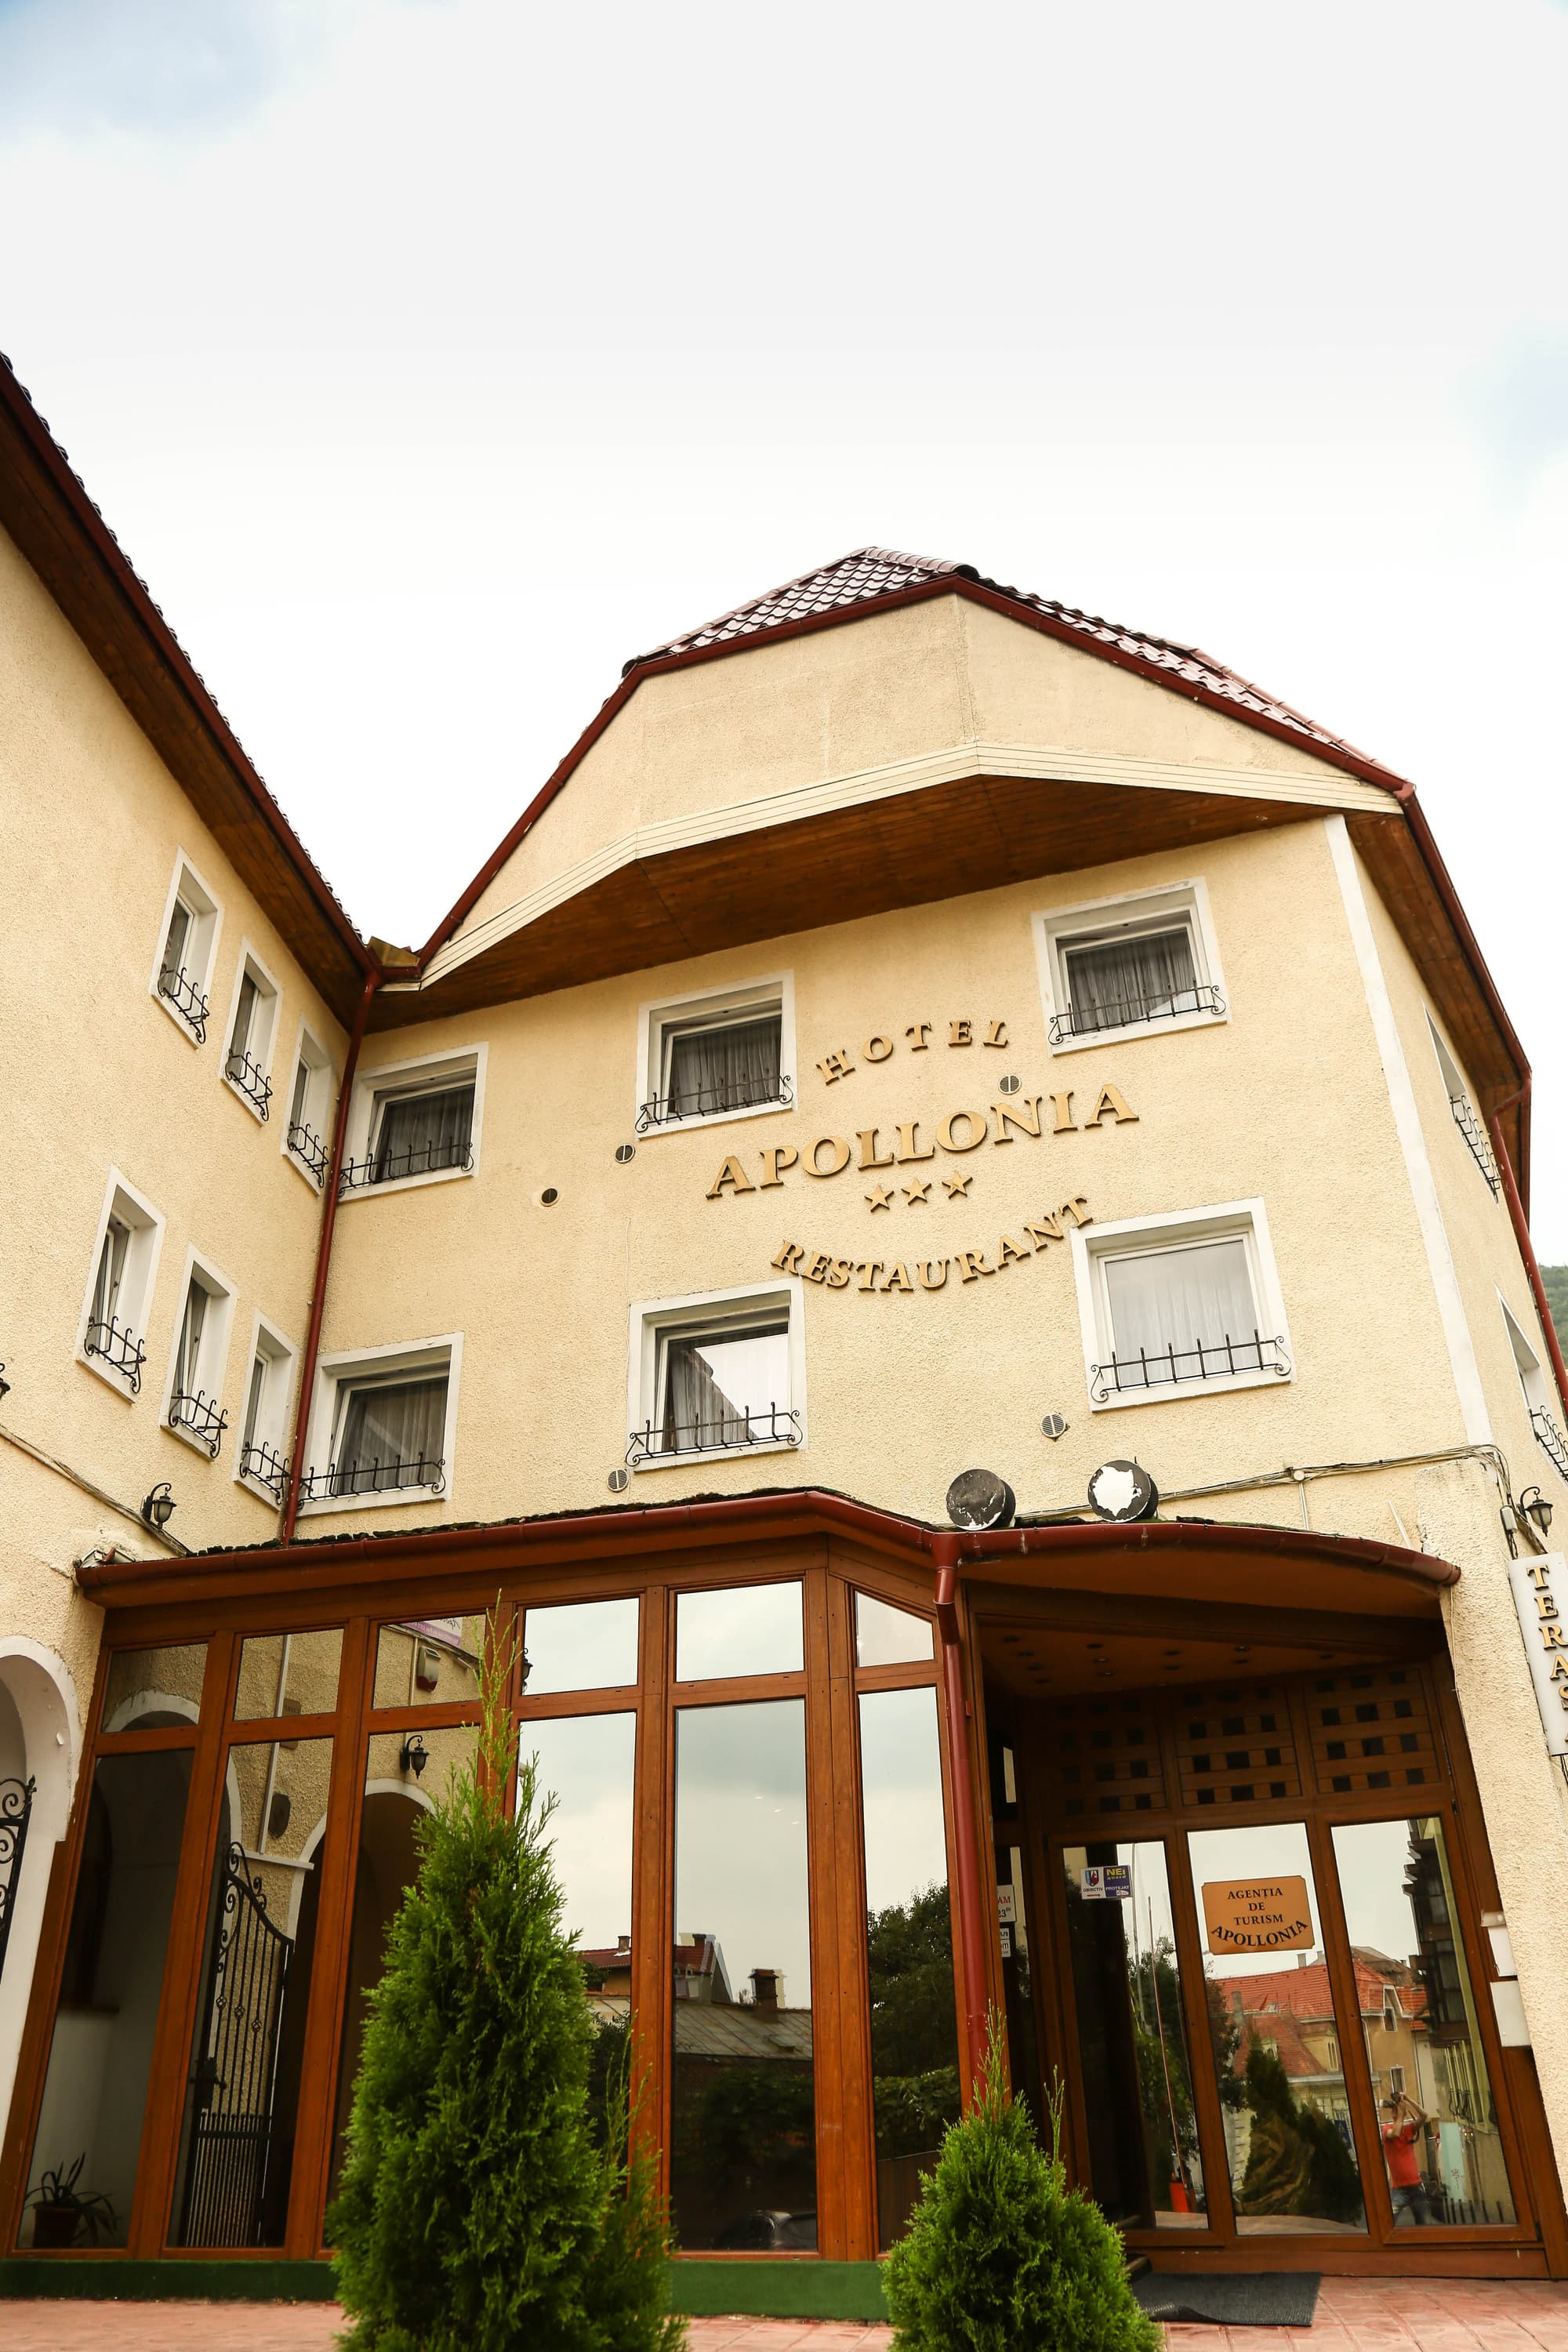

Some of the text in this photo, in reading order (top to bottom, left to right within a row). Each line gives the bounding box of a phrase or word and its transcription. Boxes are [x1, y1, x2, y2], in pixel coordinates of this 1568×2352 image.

[816, 1019, 1008, 1086] HOTEL
[706, 1083, 1139, 1200] APOLLONIA
[771, 1194, 1093, 1291] RESTAURANT
[1228, 1887, 1283, 1900] AGENȚIA
[1248, 1902, 1265, 1911] DE
[1210, 1919, 1308, 1947] APOLLONIA
[1233, 1914, 1283, 1926] TURISM
